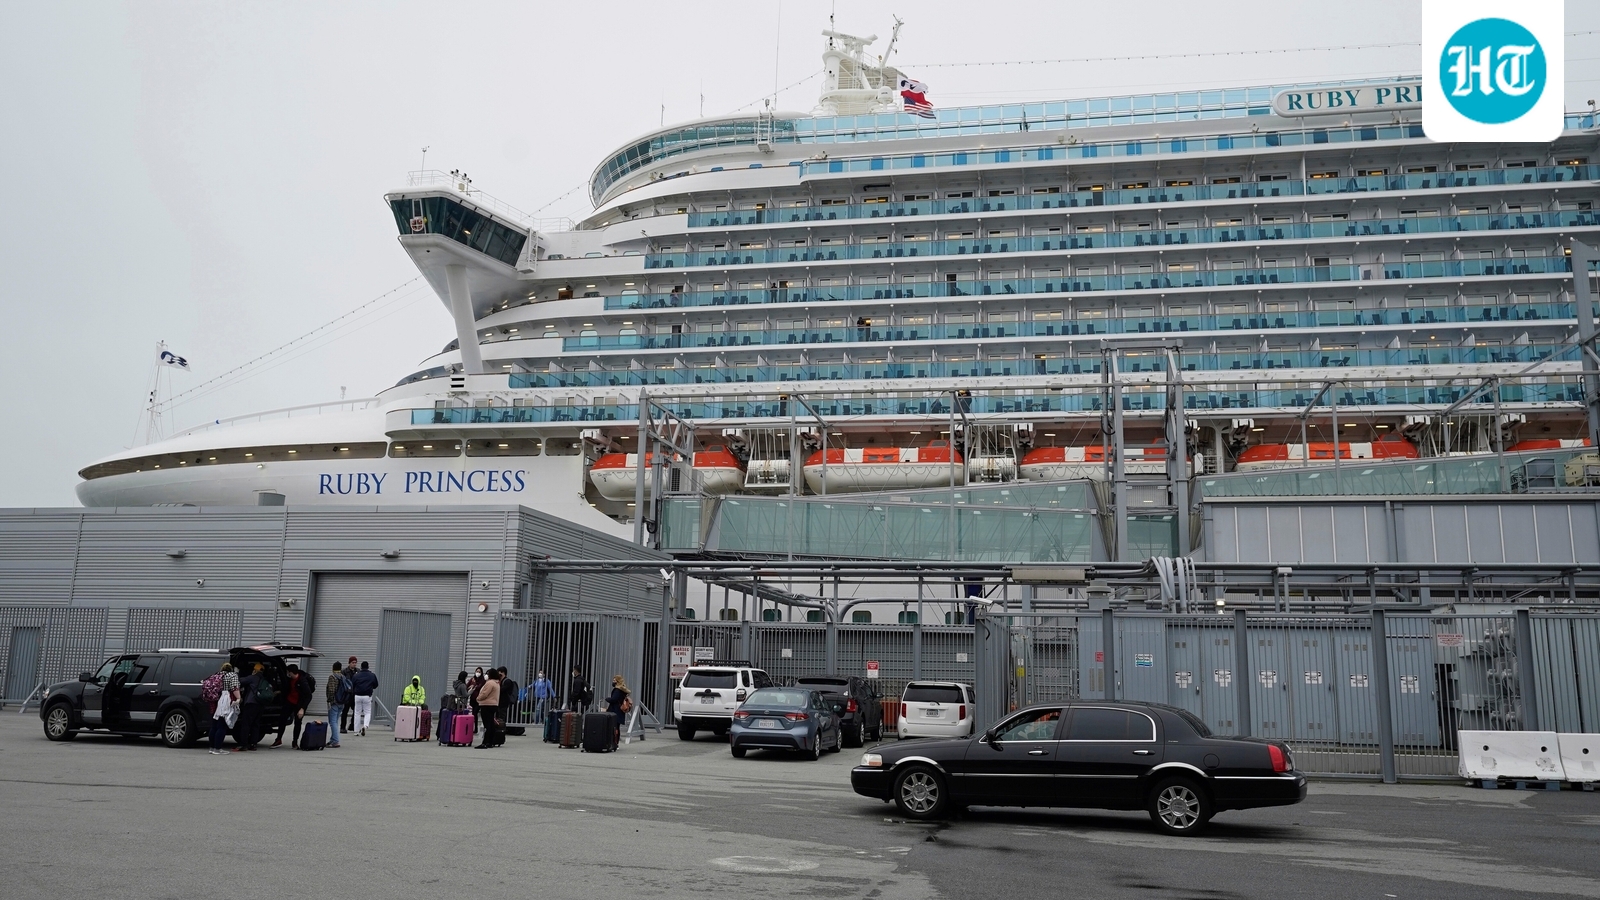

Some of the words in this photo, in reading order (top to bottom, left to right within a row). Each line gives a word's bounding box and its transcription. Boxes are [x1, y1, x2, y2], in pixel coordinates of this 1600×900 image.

[1286, 89, 1361, 111] RUBY
[318, 472, 388, 495] RUBY
[404, 469, 526, 493] PRINCESS
